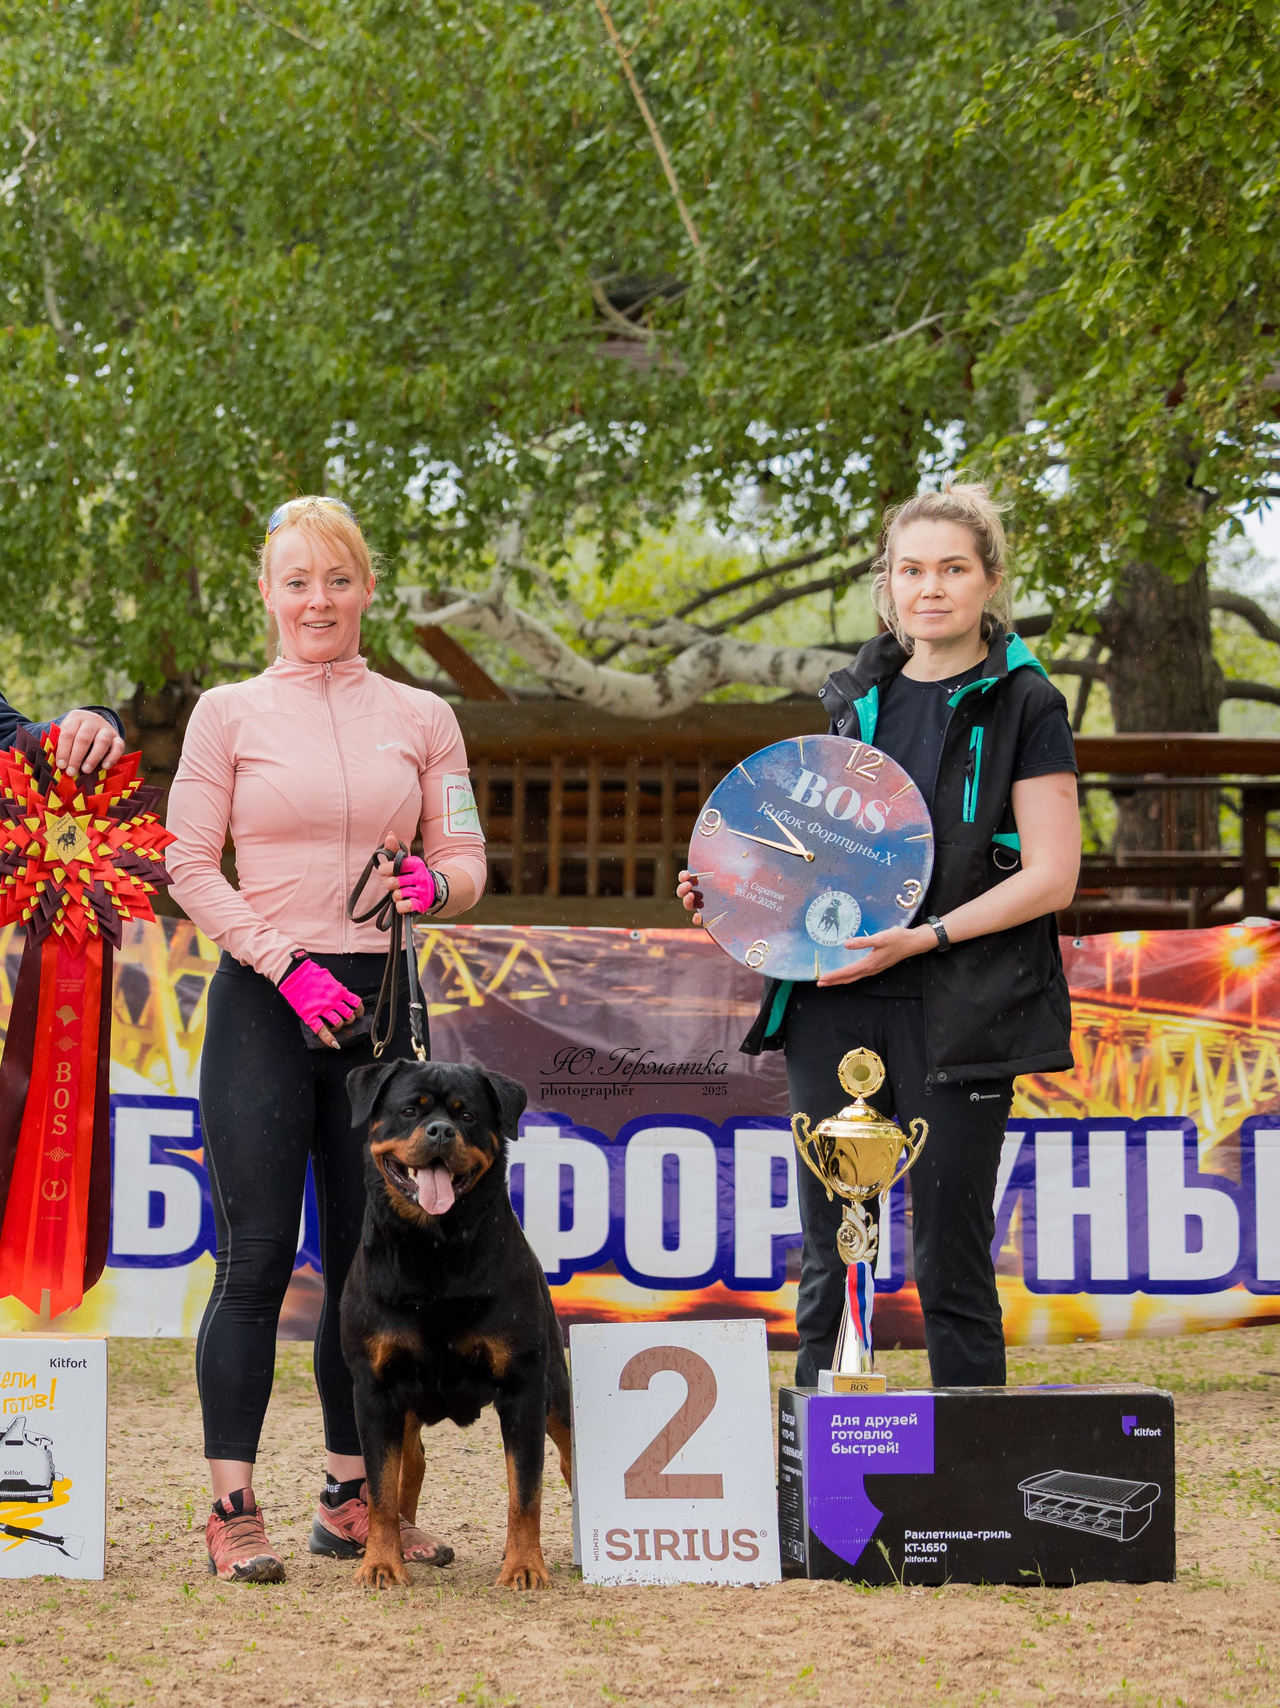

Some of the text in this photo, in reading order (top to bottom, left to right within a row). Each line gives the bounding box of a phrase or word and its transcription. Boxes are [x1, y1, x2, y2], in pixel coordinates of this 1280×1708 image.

[845, 742, 886, 782] 12
[785, 767, 893, 835] BOS
[698, 808, 722, 837] 9
[757, 800, 810, 830] Кубок
[807, 821, 879, 862] Фортуны
[734, 888, 777, 910] 26.04.2025
[750, 881, 785, 901] Саратов
[895, 879, 921, 910] 3
[744, 939, 770, 968] 6
[51, 1061, 72, 1136] BOS
[49, 1358, 88, 1369] Kitfort
[850, 1383, 869, 1392] BOS
[619, 1345, 724, 1500] 2
[831, 1413, 918, 1428] Для друзей
[831, 1430, 893, 1441] готовлю
[1133, 1427, 1162, 1437] Kitfort
[831, 1442, 900, 1456] быстрей!
[592, 1528, 600, 1562] PREMIUM
[605, 1528, 760, 1562] SIRIUS
[904, 1529, 1012, 1541] Раклетница-гриль
[904, 1543, 948, 1553] KT-1650
[904, 1555, 938, 1563] kitfort.ru
